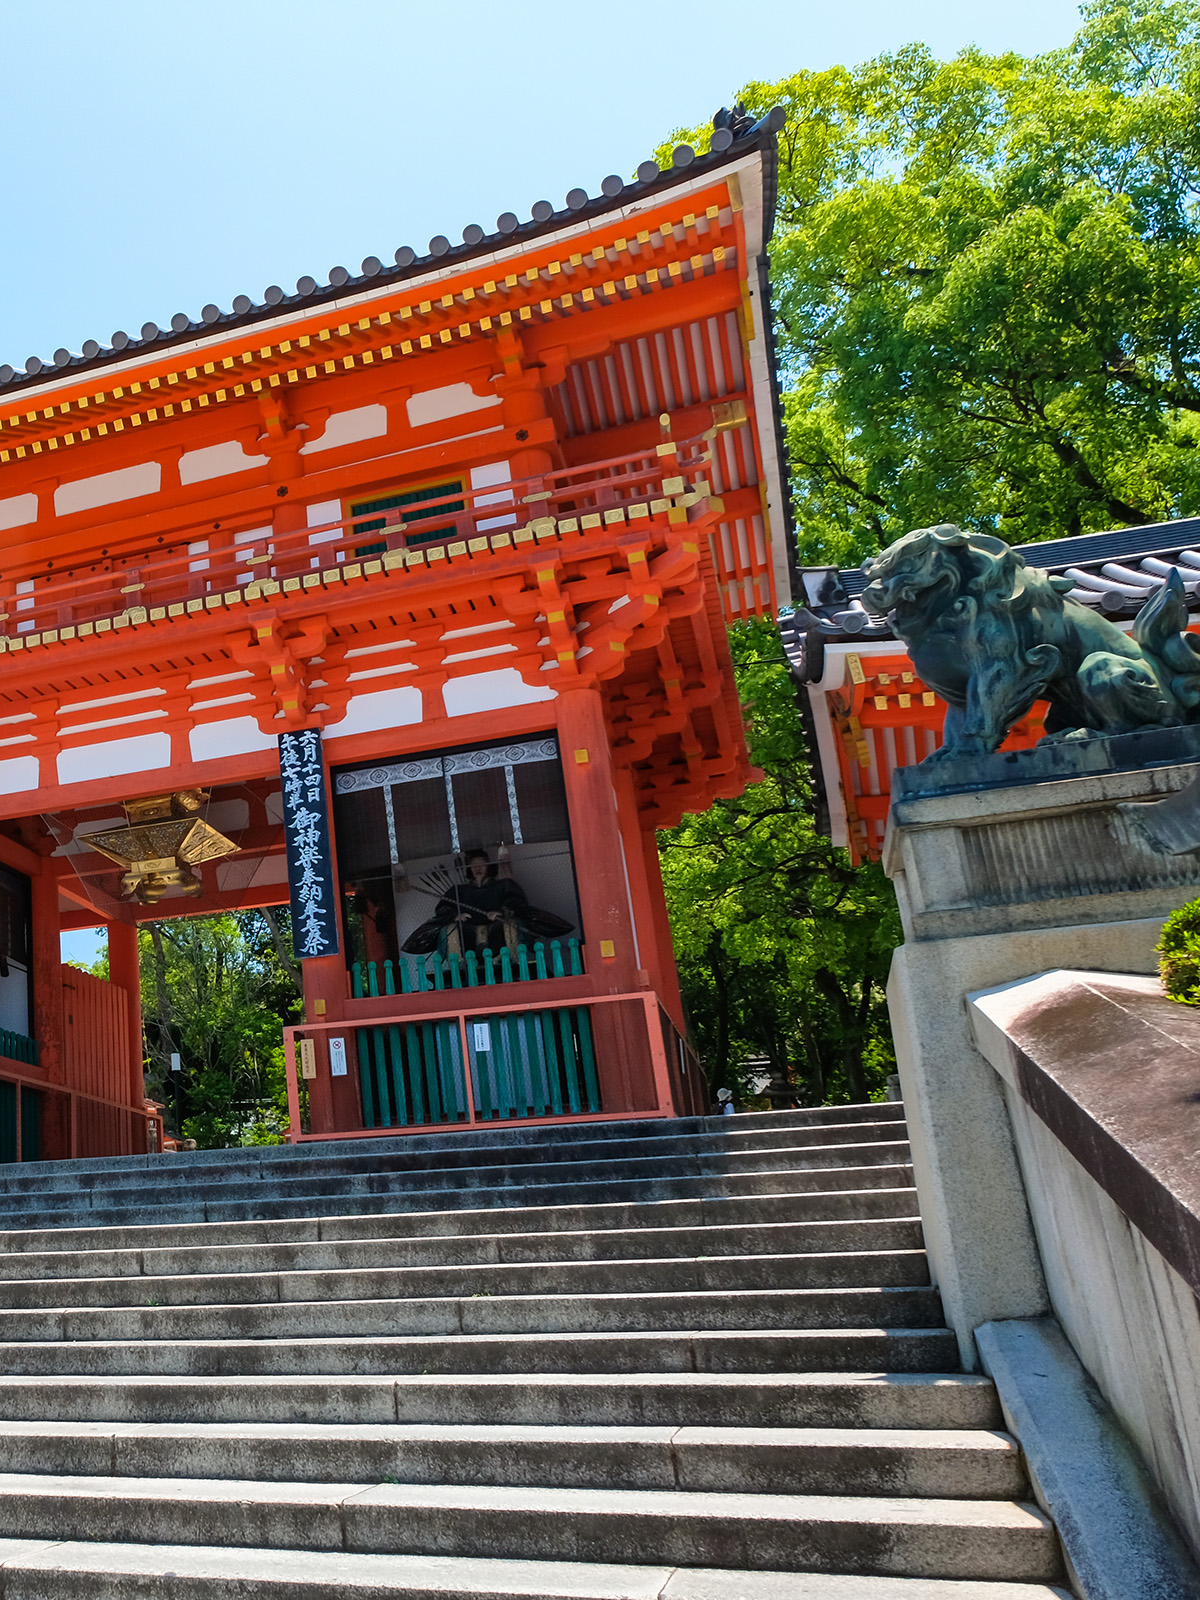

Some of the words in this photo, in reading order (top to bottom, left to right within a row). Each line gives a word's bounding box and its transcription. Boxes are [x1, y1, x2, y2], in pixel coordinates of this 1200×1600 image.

[280, 733, 302, 811] 午後七時半
[301, 731, 321, 802] 六月十四日
